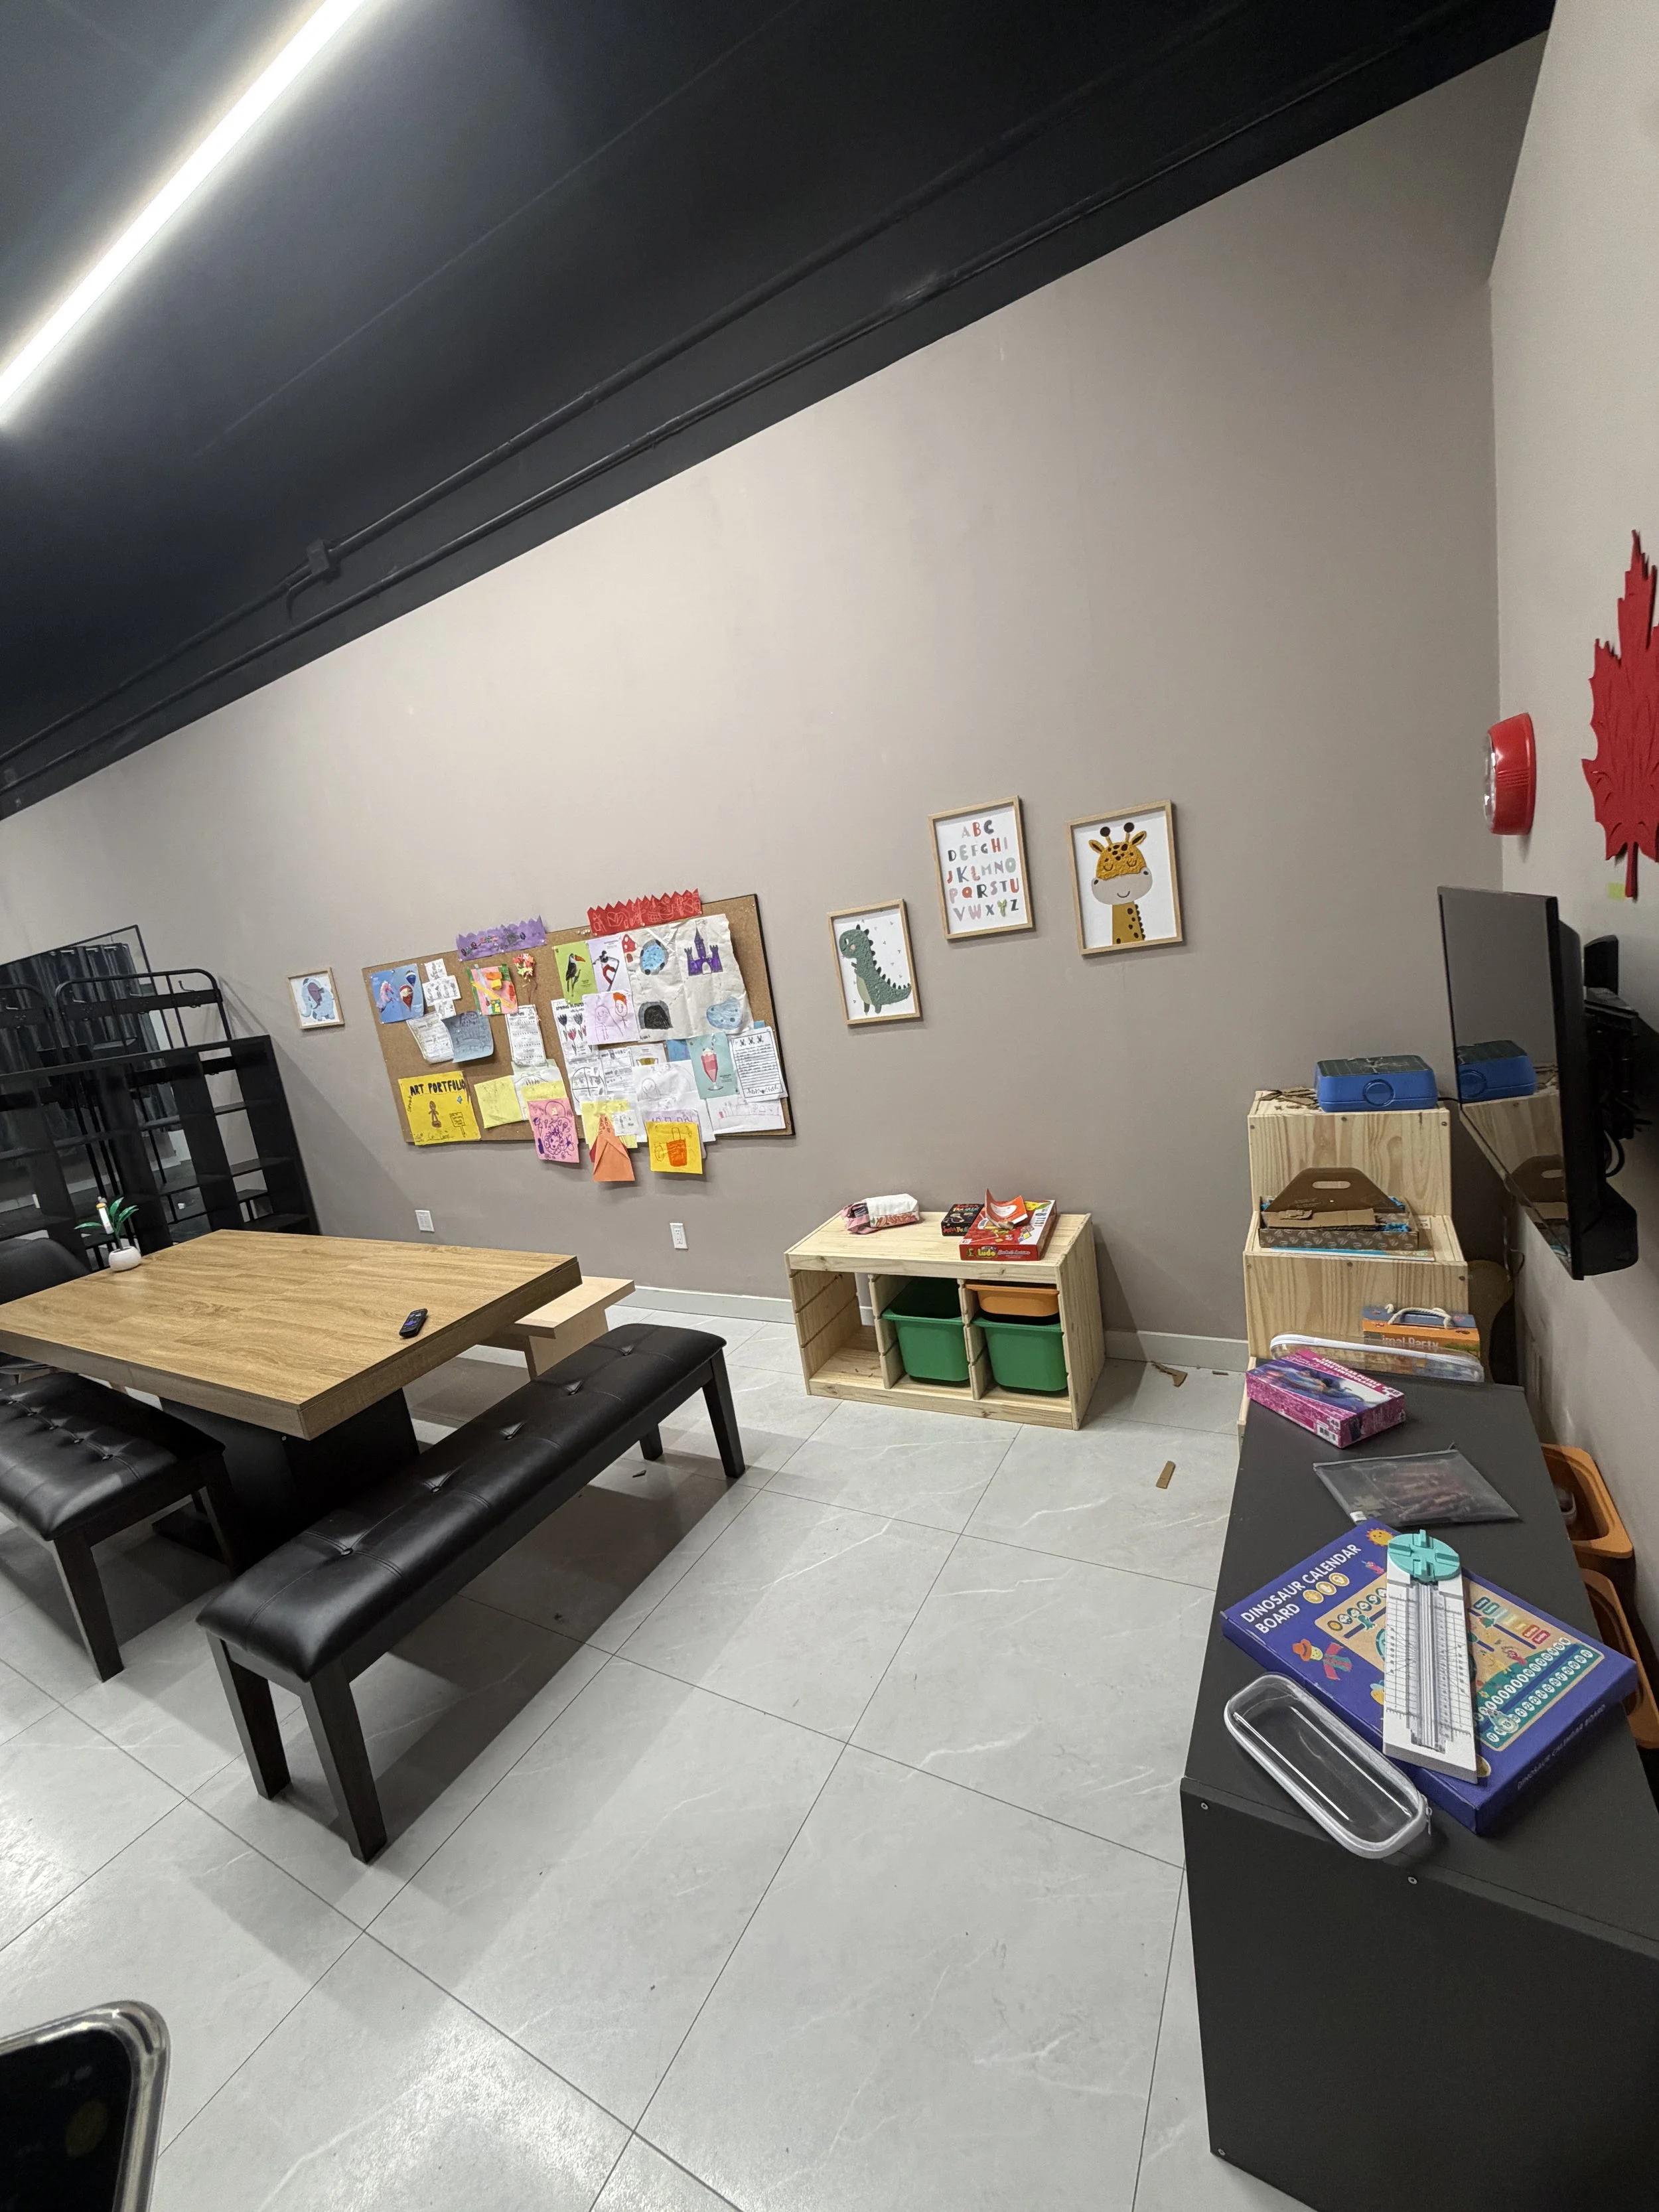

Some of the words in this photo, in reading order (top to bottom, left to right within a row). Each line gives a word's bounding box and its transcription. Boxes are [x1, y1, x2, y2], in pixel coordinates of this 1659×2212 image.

[409, 1084, 424, 1096] ART
[428, 1079, 466, 1094] PORTFOLIO
[1313, 1357, 1334, 1369] PUZZLE
[1334, 1367, 1376, 1388] LENTICULAIRE
[1321, 1358, 1358, 1376] LENTICULAR
[1357, 1374, 1382, 1386] PUZZLE
[1240, 1581, 1305, 1623] DINOSAUR
[1302, 1544, 1362, 1584] CALENDAR
[1255, 1603, 1300, 1633] BOARD
